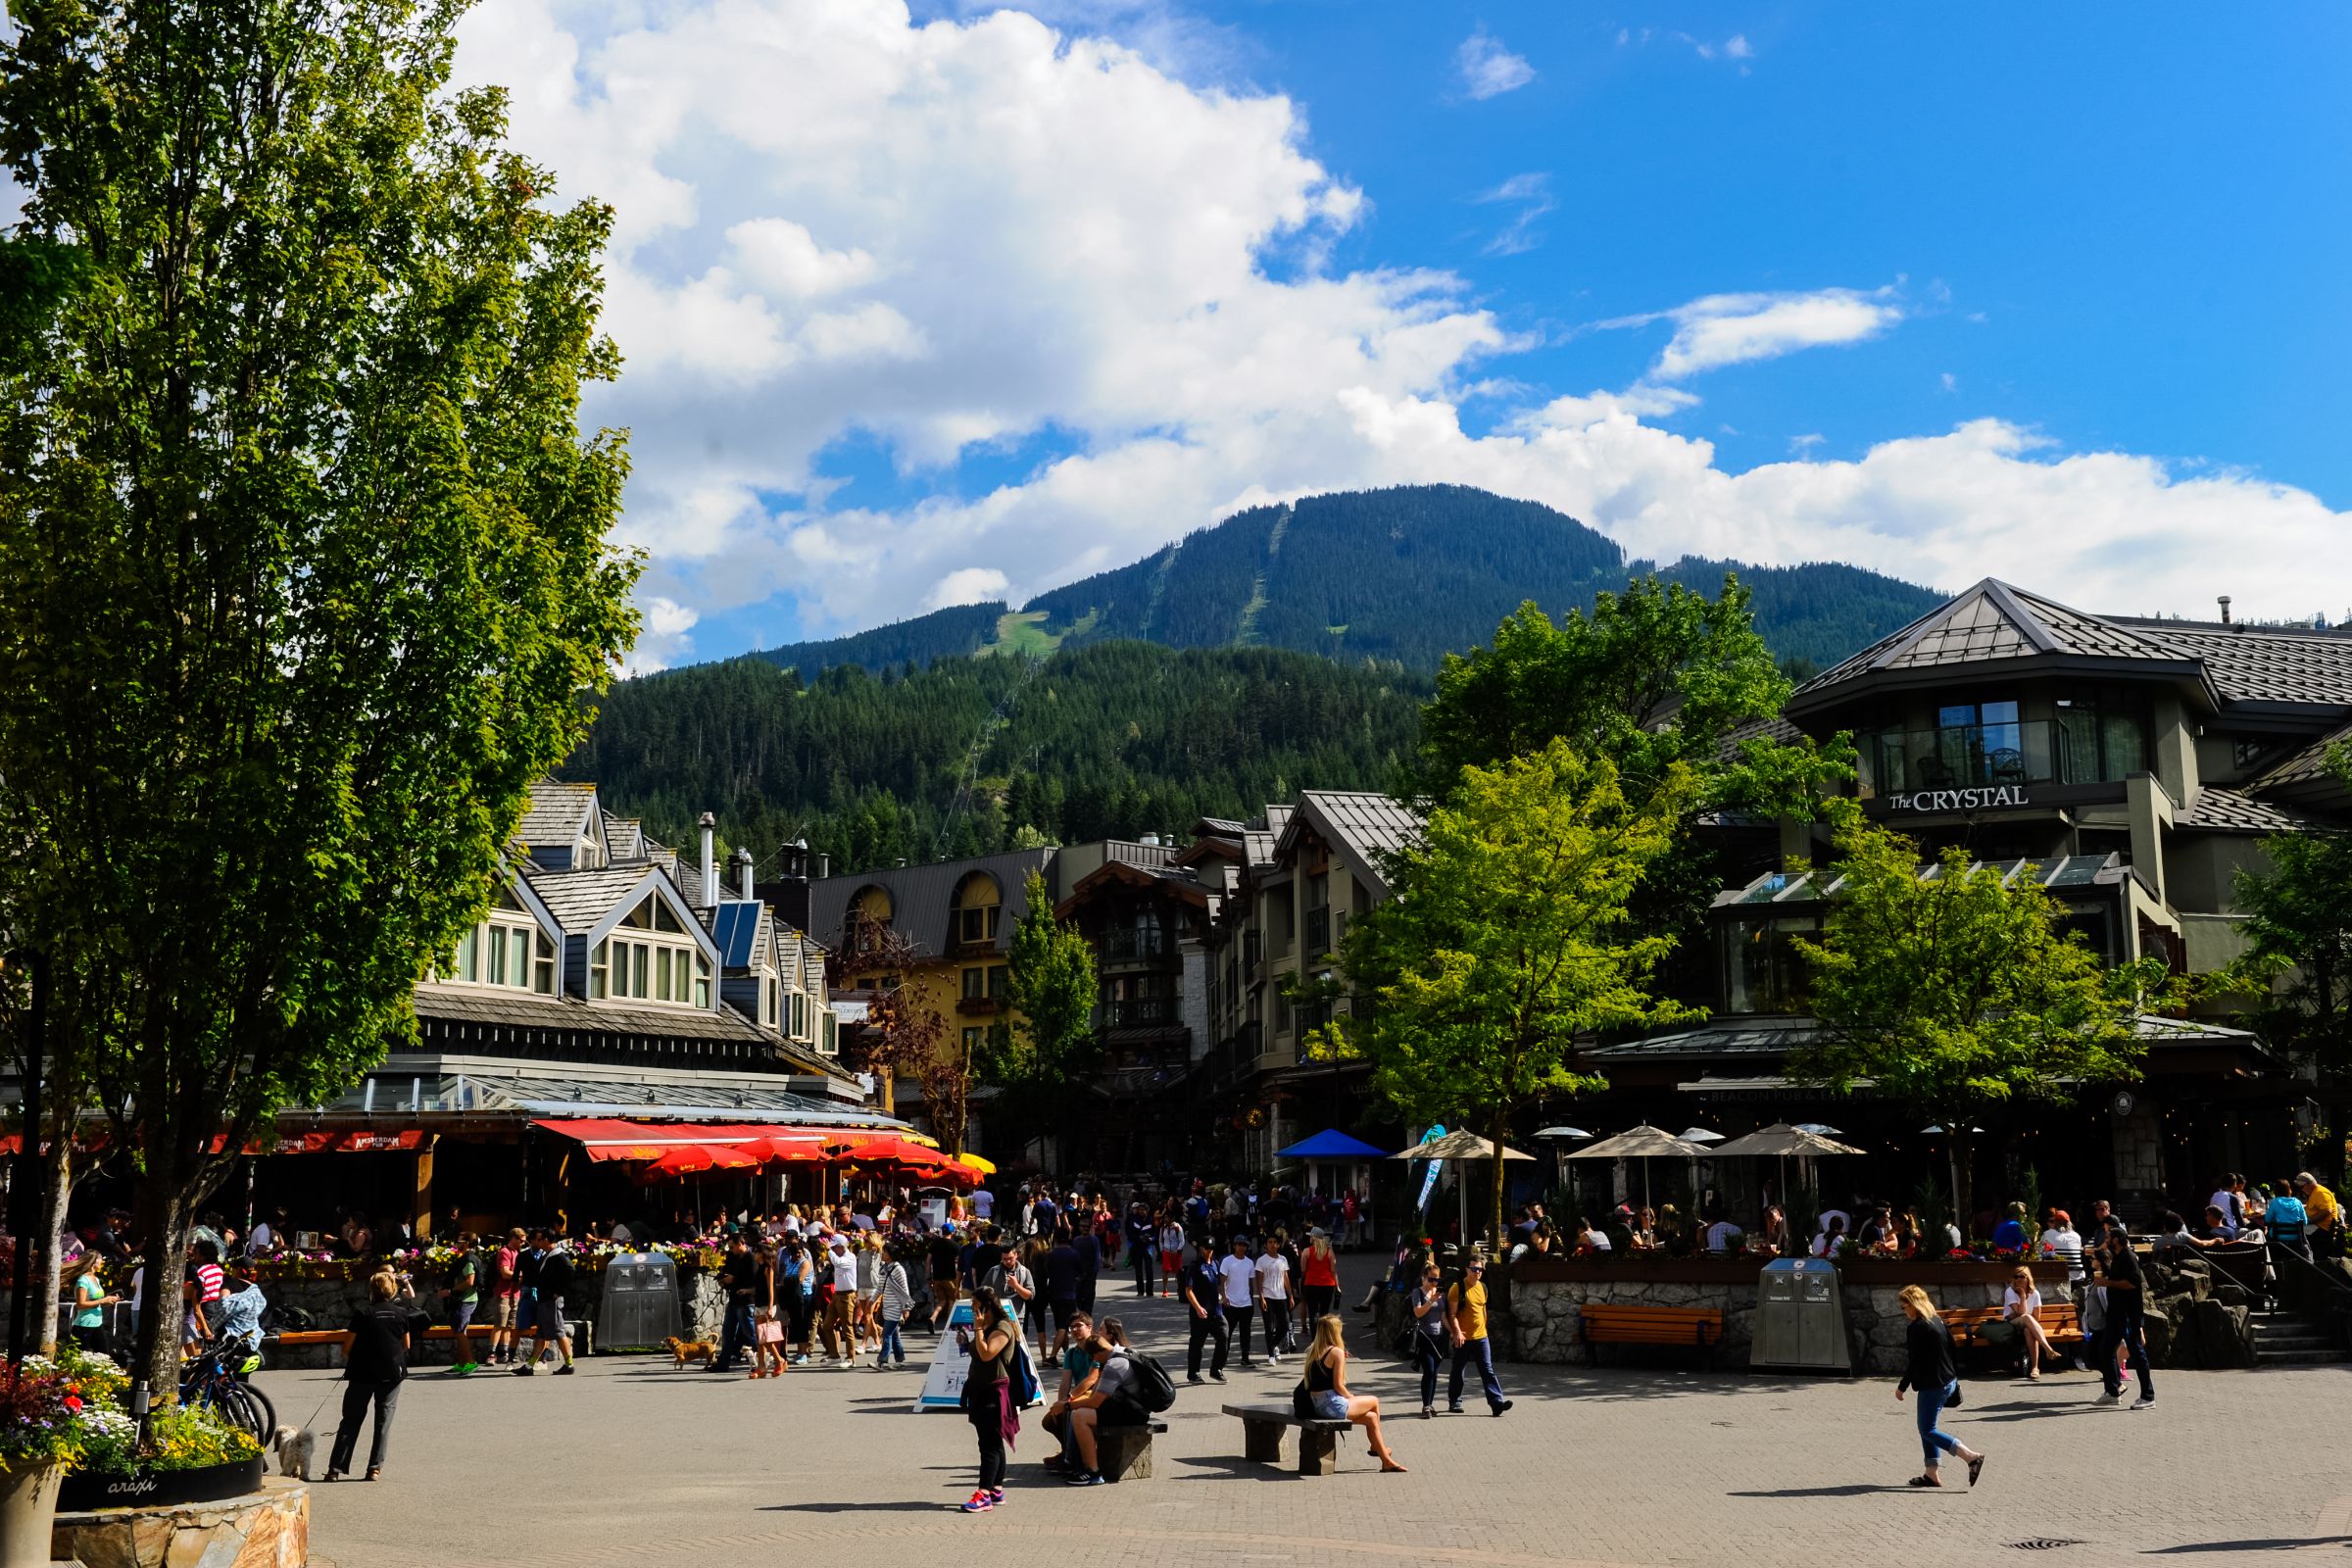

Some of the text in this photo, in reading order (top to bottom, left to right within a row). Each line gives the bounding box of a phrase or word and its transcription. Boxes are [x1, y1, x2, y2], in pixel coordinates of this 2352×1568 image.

[1889, 785, 2029, 811] The CRYSTAL
[1711, 1091, 1770, 1102] BEACON
[1774, 1090, 1802, 1102] PUB
[1820, 1090, 1872, 1102] ETERY
[356, 1137, 399, 1149] AMSTERDAM
[108, 1474, 157, 1495] araxi
